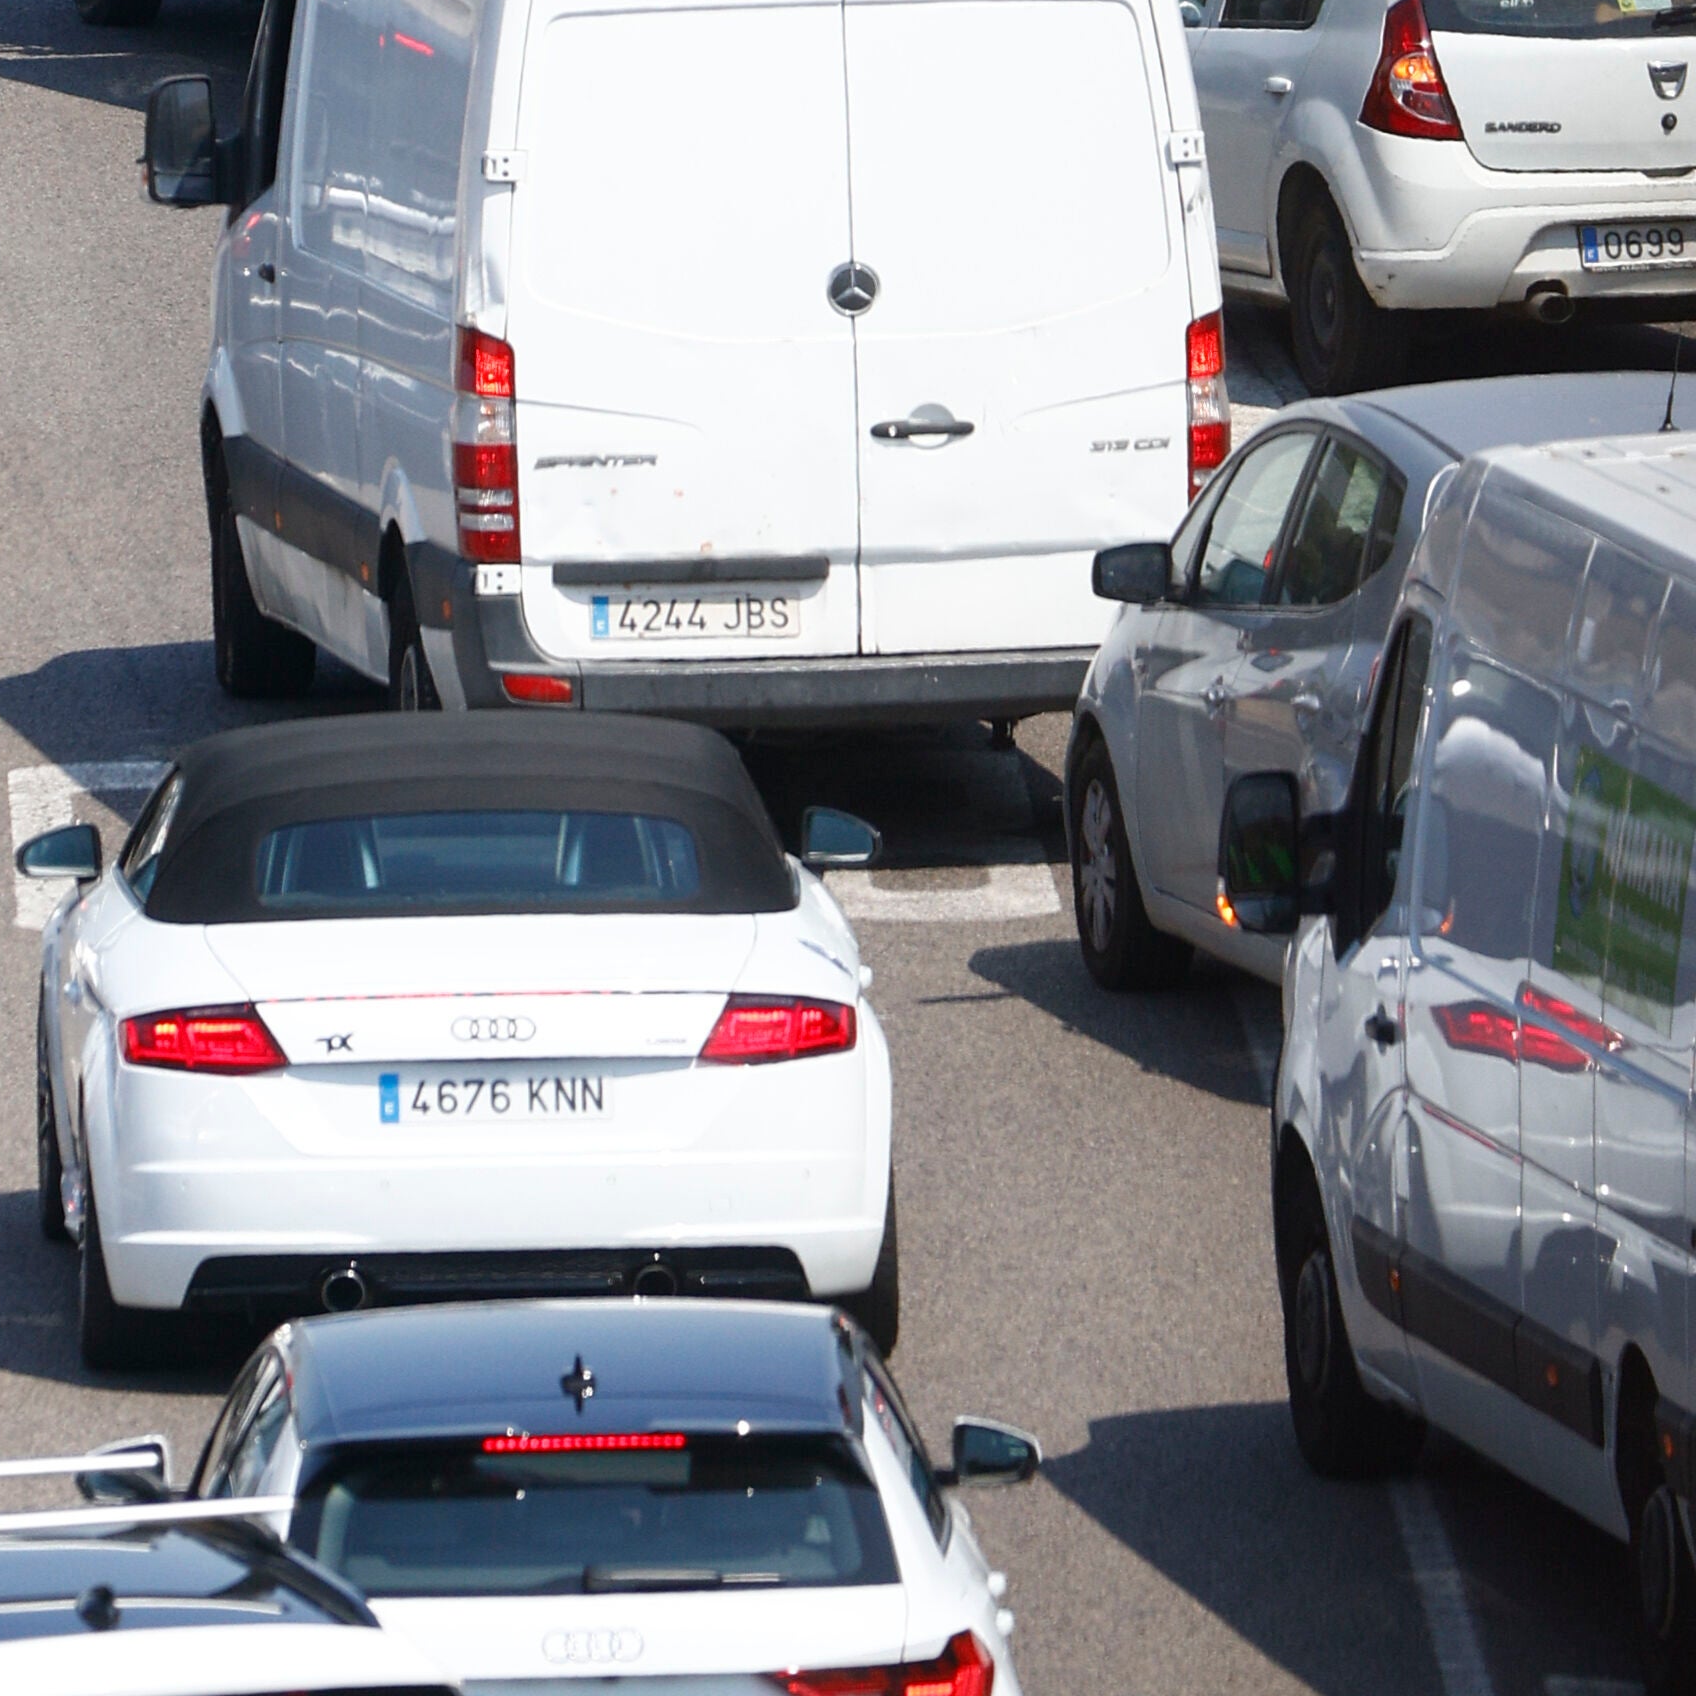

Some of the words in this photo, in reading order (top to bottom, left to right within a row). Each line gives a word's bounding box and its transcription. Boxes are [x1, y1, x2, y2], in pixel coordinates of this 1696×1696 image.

[1484, 121, 1562, 134] SANDERO
[1604, 227, 1684, 260] 0699
[533, 454, 658, 470] SPRINTER
[618, 597, 707, 633] 4244
[723, 596, 789, 631] JBS
[411, 1079, 511, 1115] 4676
[528, 1076, 604, 1113] KNN
